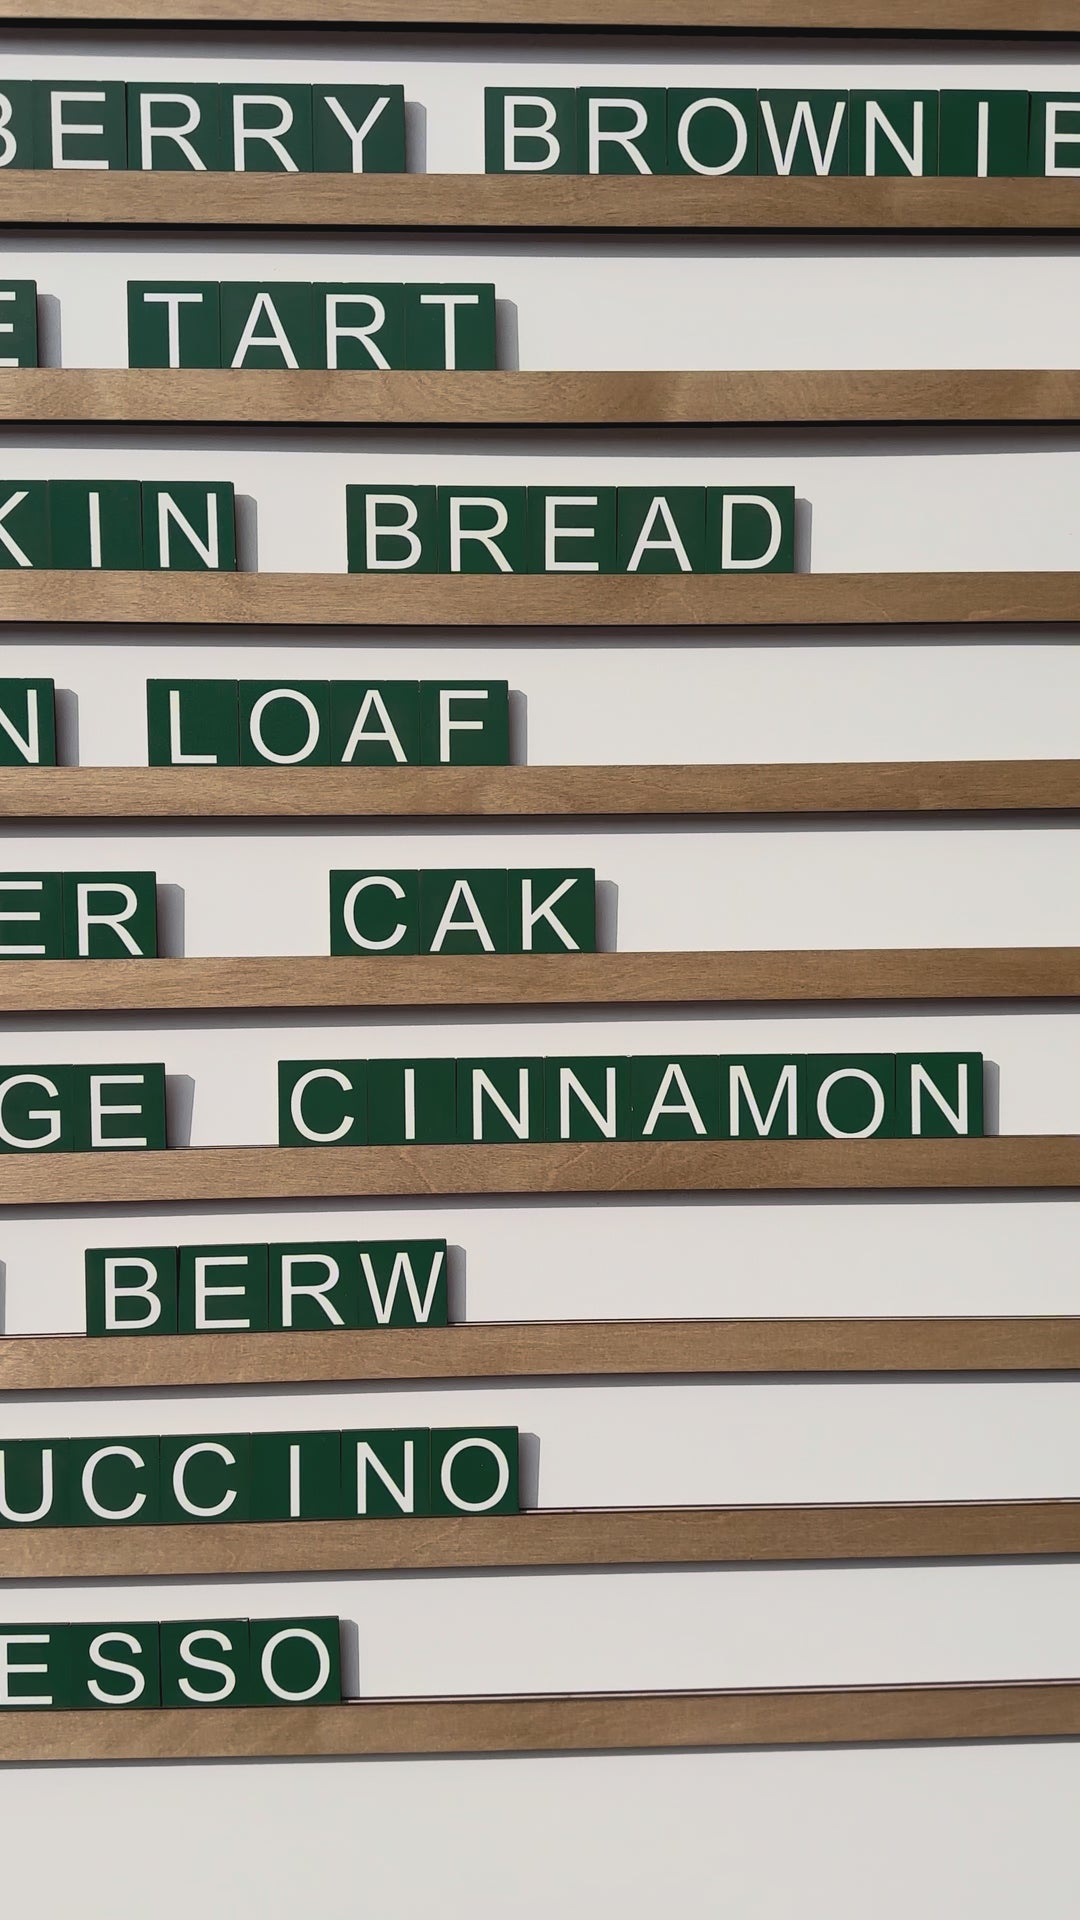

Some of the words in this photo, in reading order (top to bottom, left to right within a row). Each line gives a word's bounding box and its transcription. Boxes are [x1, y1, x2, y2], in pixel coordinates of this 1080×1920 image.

[503, 95, 1080, 178] BROWNIE
[143, 292, 479, 370] TART
[0, 491, 219, 569] KIN
[364, 494, 782, 573] BREAD
[0, 689, 40, 764] N
[169, 688, 490, 764] LOAF
[0, 880, 144, 956] ER
[342, 875, 581, 952] CAK
[0, 1073, 148, 1149] GE
[290, 1063, 970, 1142] CINNAMON
[103, 1251, 445, 1330] BERW
[0, 1437, 511, 1523] UCCINO
[0, 1628, 331, 1706] ESSO
